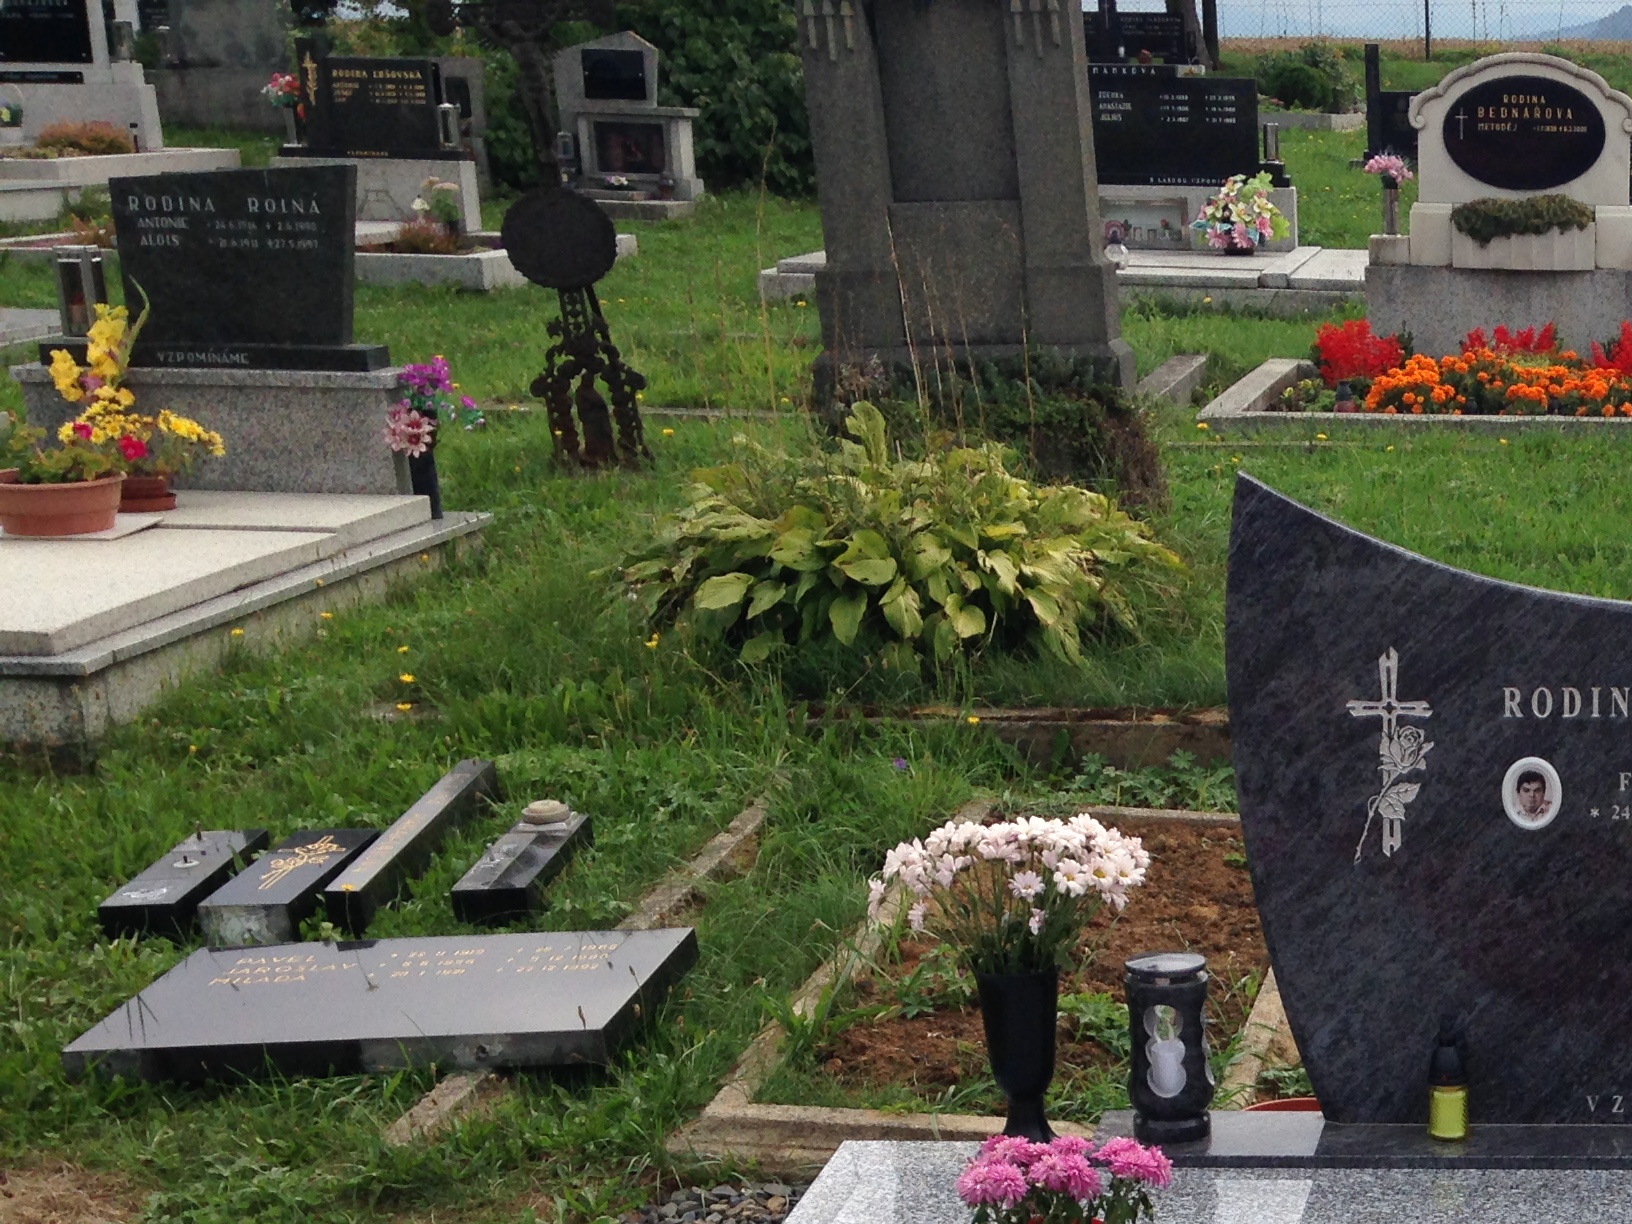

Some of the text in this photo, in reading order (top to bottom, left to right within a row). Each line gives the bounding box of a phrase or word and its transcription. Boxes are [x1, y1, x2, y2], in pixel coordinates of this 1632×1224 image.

[1503, 94, 1546, 104] RODINA
[1477, 106, 1573, 120] BEDNAŘOVA
[128, 195, 216, 213] RODINA
[140, 234, 180, 247] ALOIS
[157, 347, 250, 365] VZPOMÍNÁME
[236, 955, 315, 965] PAVEL
[227, 962, 358, 975] JAROSLAV
[208, 974, 306, 987] MILADA
